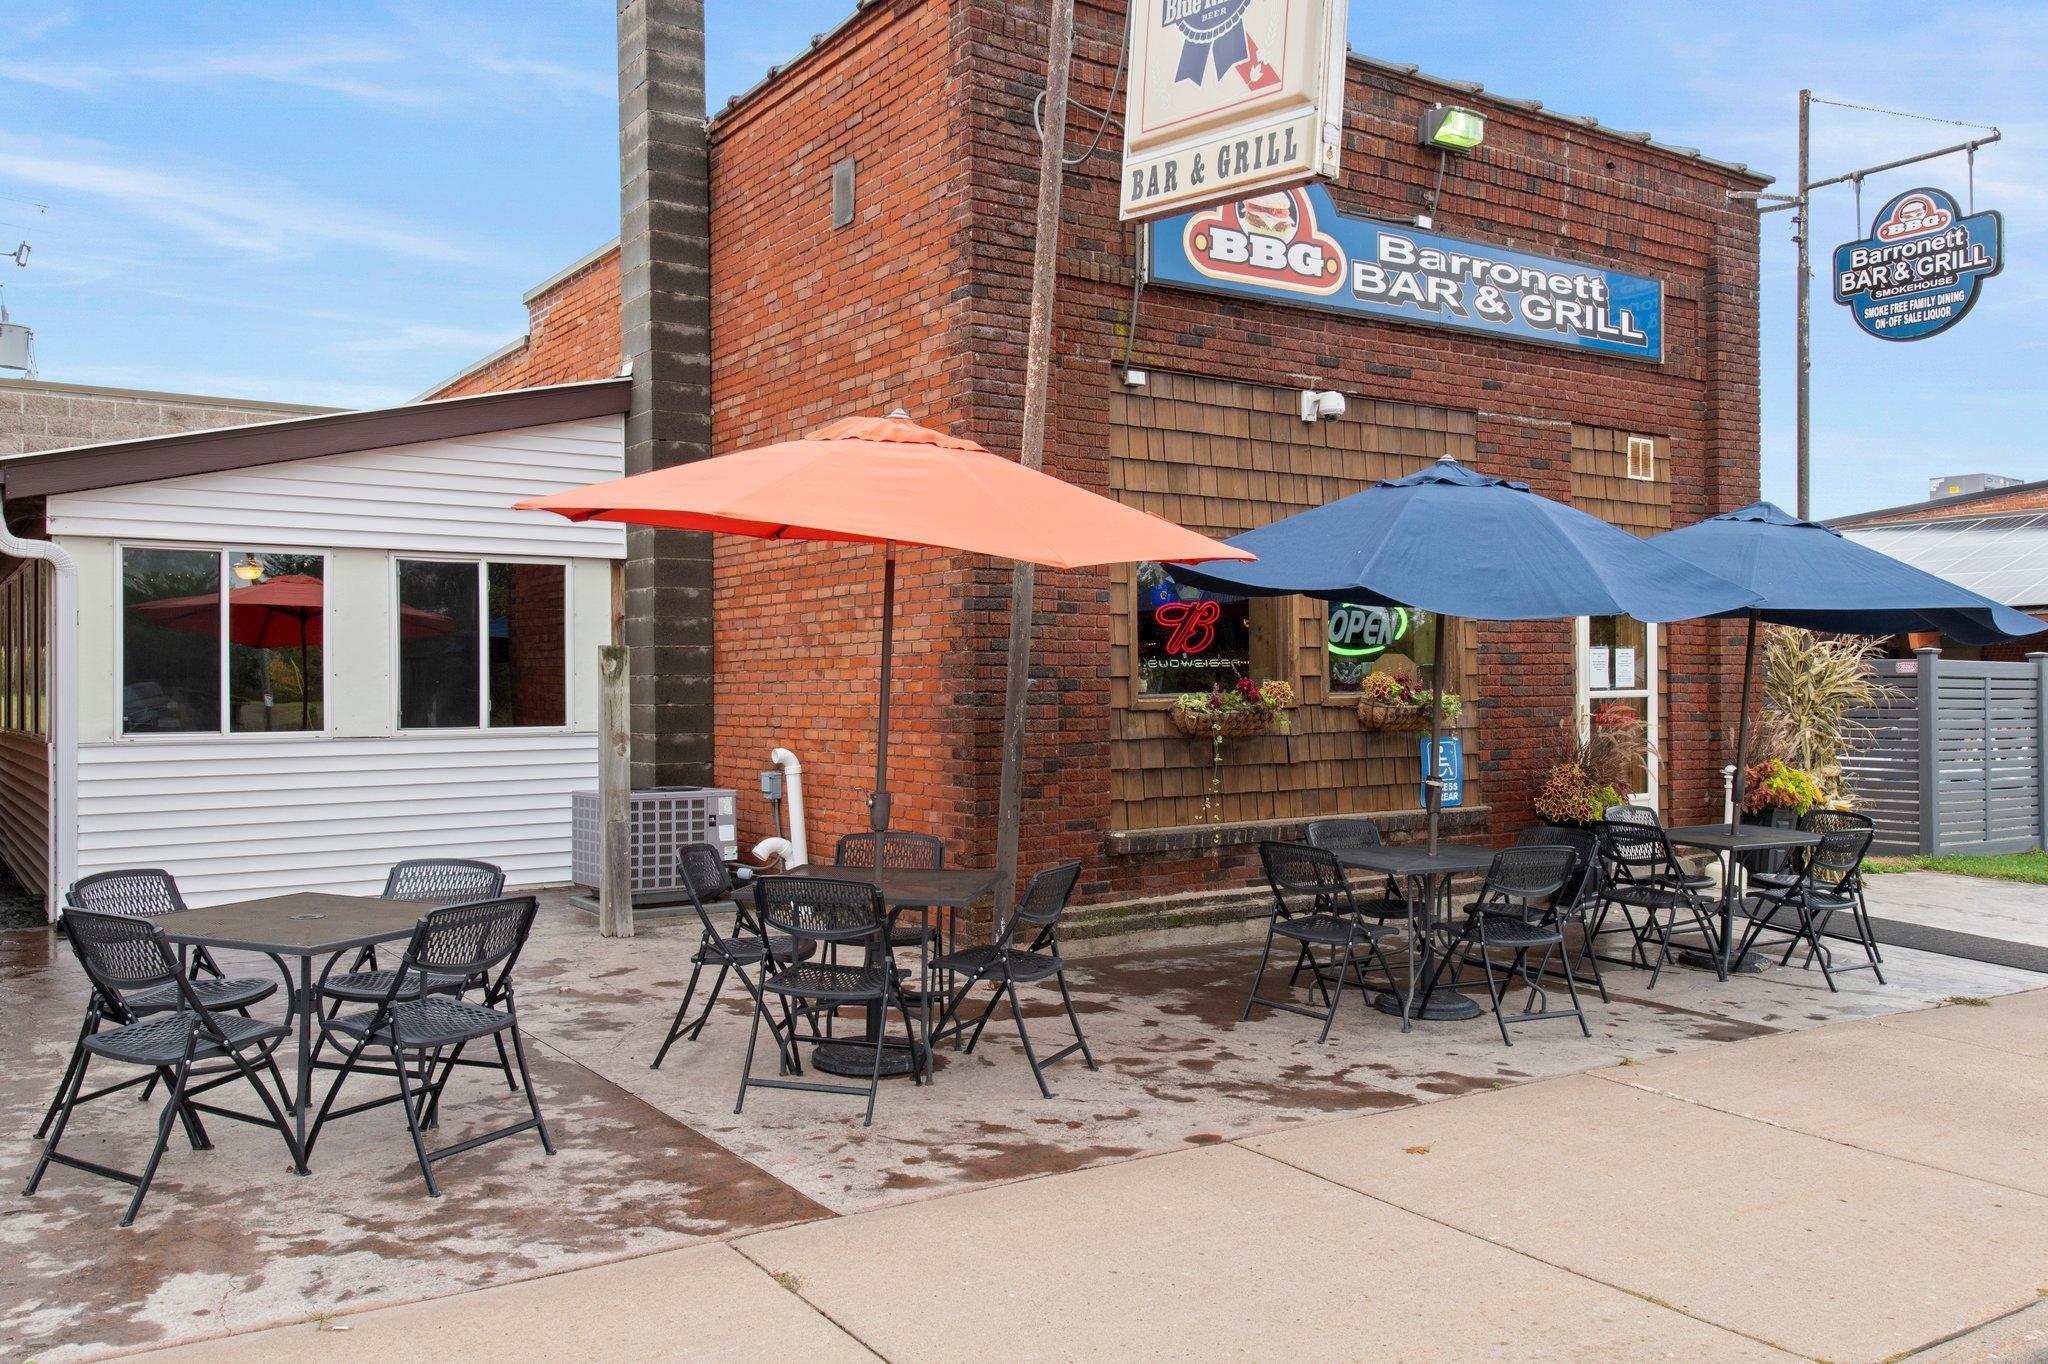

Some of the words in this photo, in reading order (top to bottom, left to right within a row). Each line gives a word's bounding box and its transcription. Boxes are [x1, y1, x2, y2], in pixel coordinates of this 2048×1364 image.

[1164, 0, 1201, 24] Blue
[1201, 7, 1227, 22] BEER
[1131, 160, 1178, 201] BAR
[1190, 152, 1205, 186] &
[1216, 126, 1298, 179] GRILL
[1888, 215, 1940, 236] BBG
[1208, 226, 1325, 278] BBG
[1851, 226, 1965, 268] Barronett
[1378, 233, 1606, 302] Barronett
[1841, 265, 1887, 292] BAR
[1894, 261, 1910, 281] &
[1917, 245, 1988, 276] GRILL
[1352, 261, 1462, 309] BAR
[1474, 285, 1507, 316] &
[1520, 294, 1645, 340] GRILL
[1864, 304, 1889, 319] SMOKE
[1890, 301, 1908, 314] FREE
[1909, 295, 1936, 311] FAMILY
[1937, 290, 1965, 305] DINING
[1875, 276, 1953, 298] SMOKEHOUSE
[1875, 315, 1901, 330] ON-OFF
[1903, 311, 1922, 325] SALE
[1923, 306, 1952, 321] LIQUOR
[1328, 609, 1399, 645] OPEN
